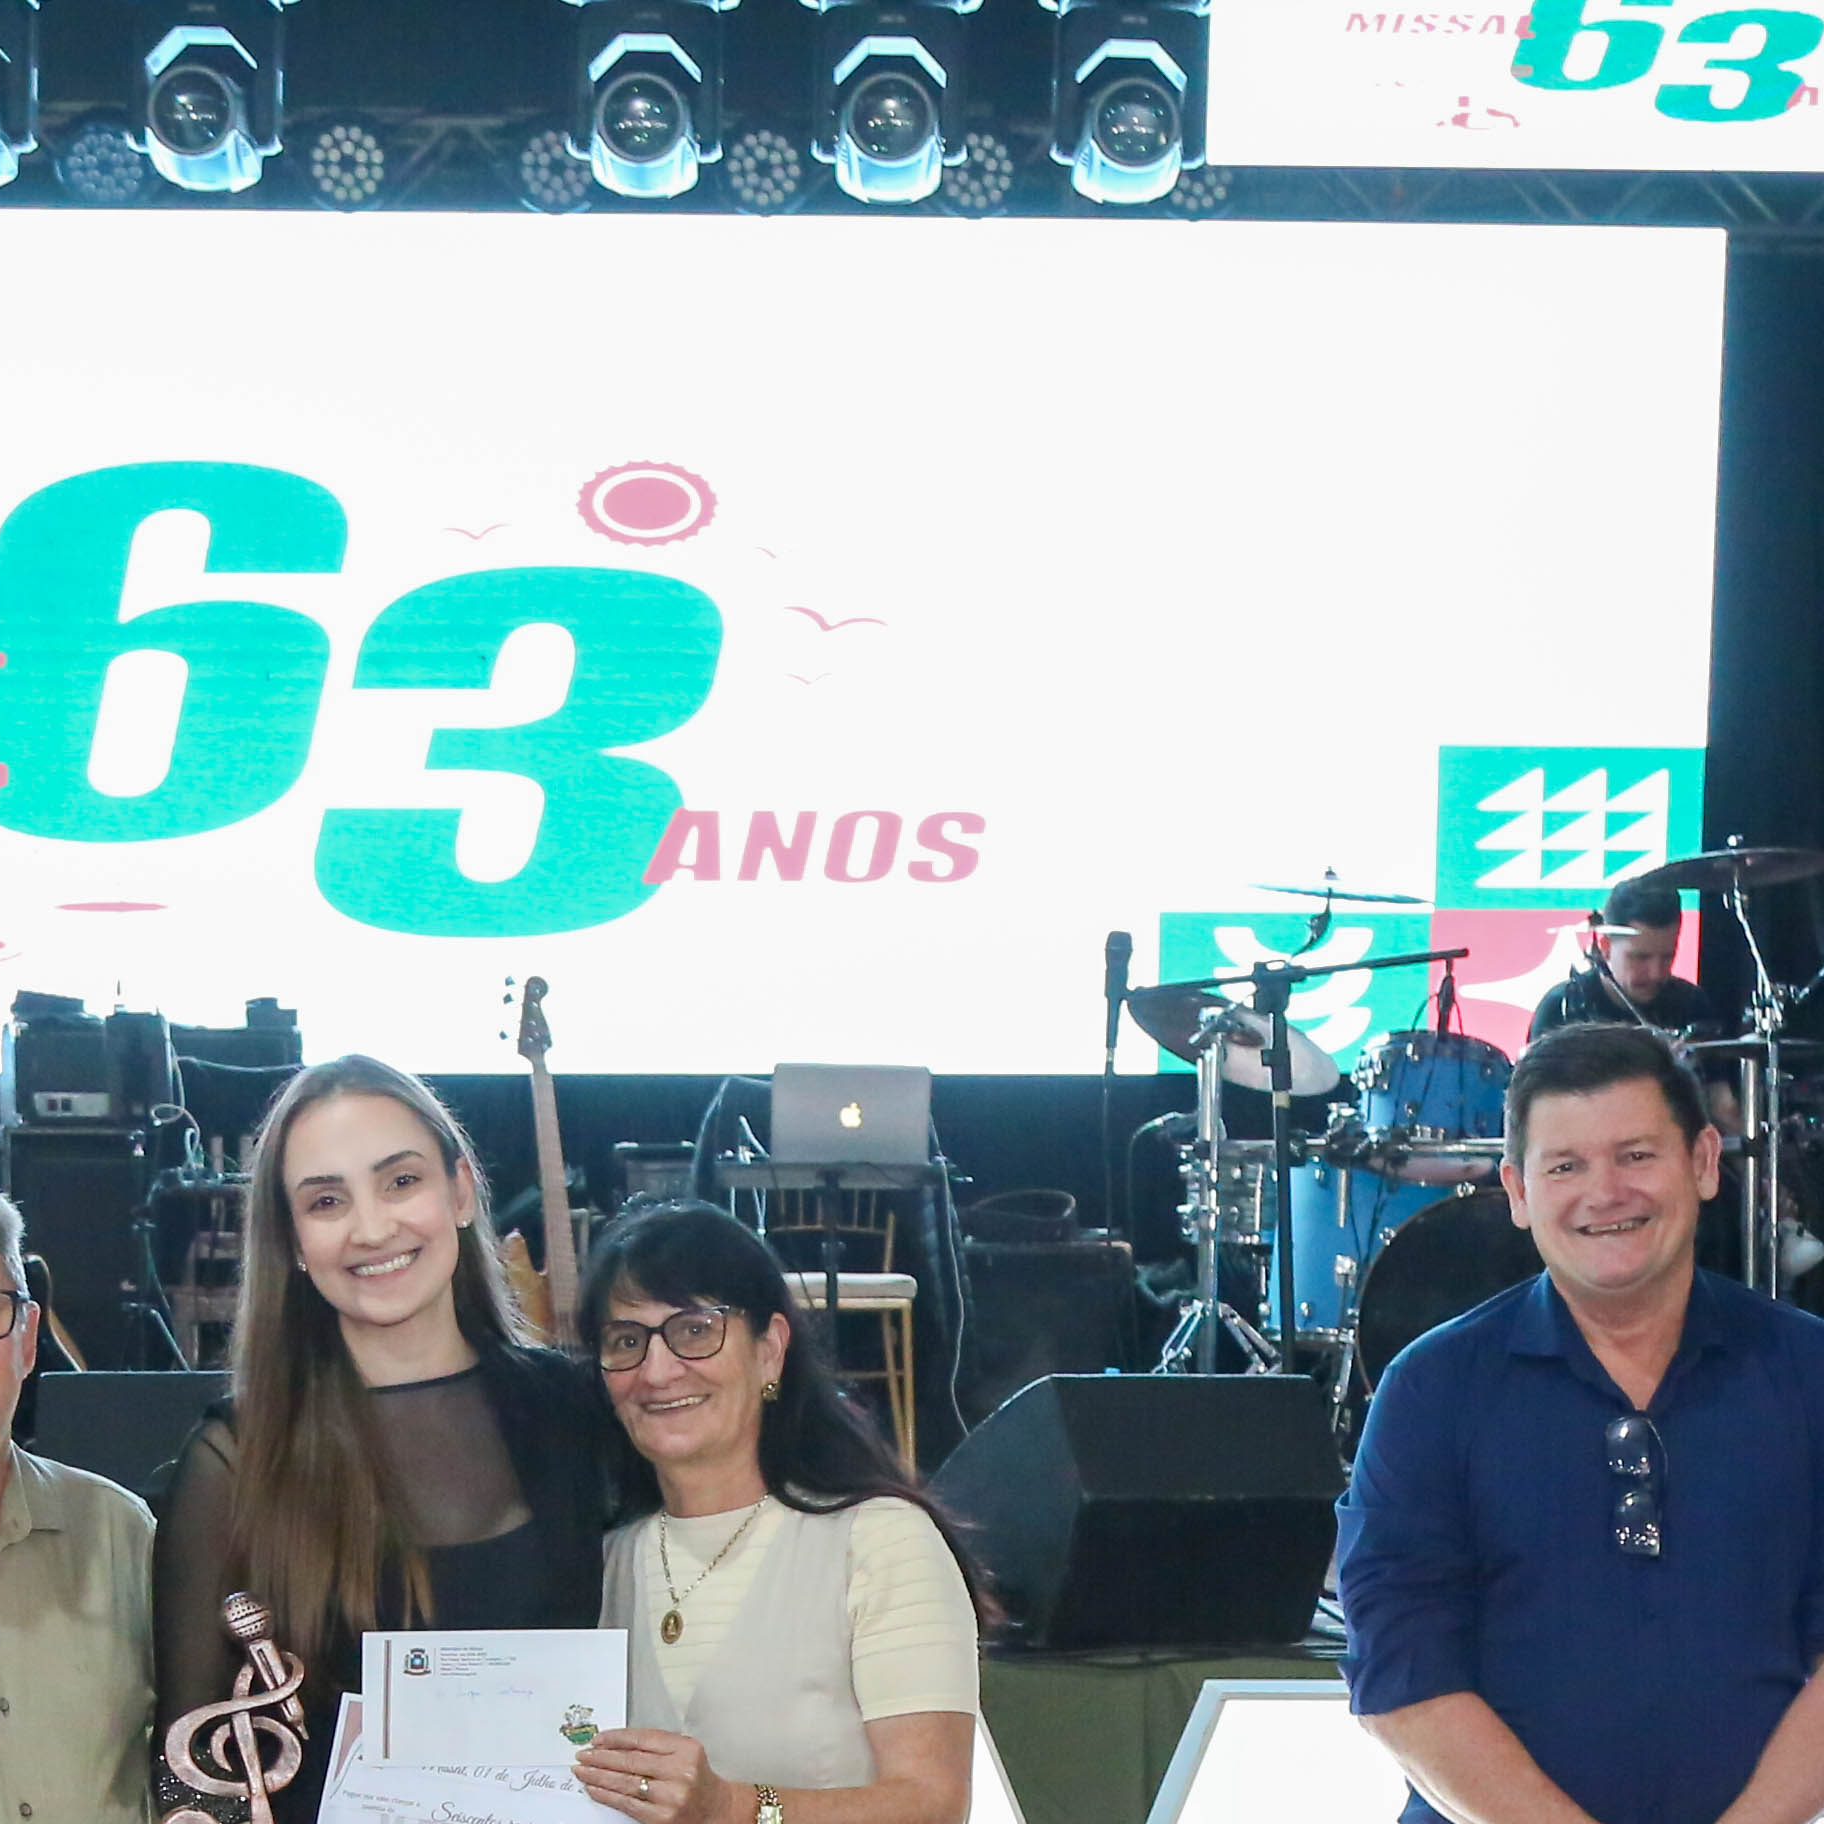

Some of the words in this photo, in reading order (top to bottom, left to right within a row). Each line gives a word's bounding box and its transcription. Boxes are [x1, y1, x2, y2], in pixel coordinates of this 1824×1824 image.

[641, 808, 987, 886] ANOS
[495, 1767, 510, 1782] de
[509, 1766, 556, 1791] Julho
[559, 1777, 573, 1792] de
